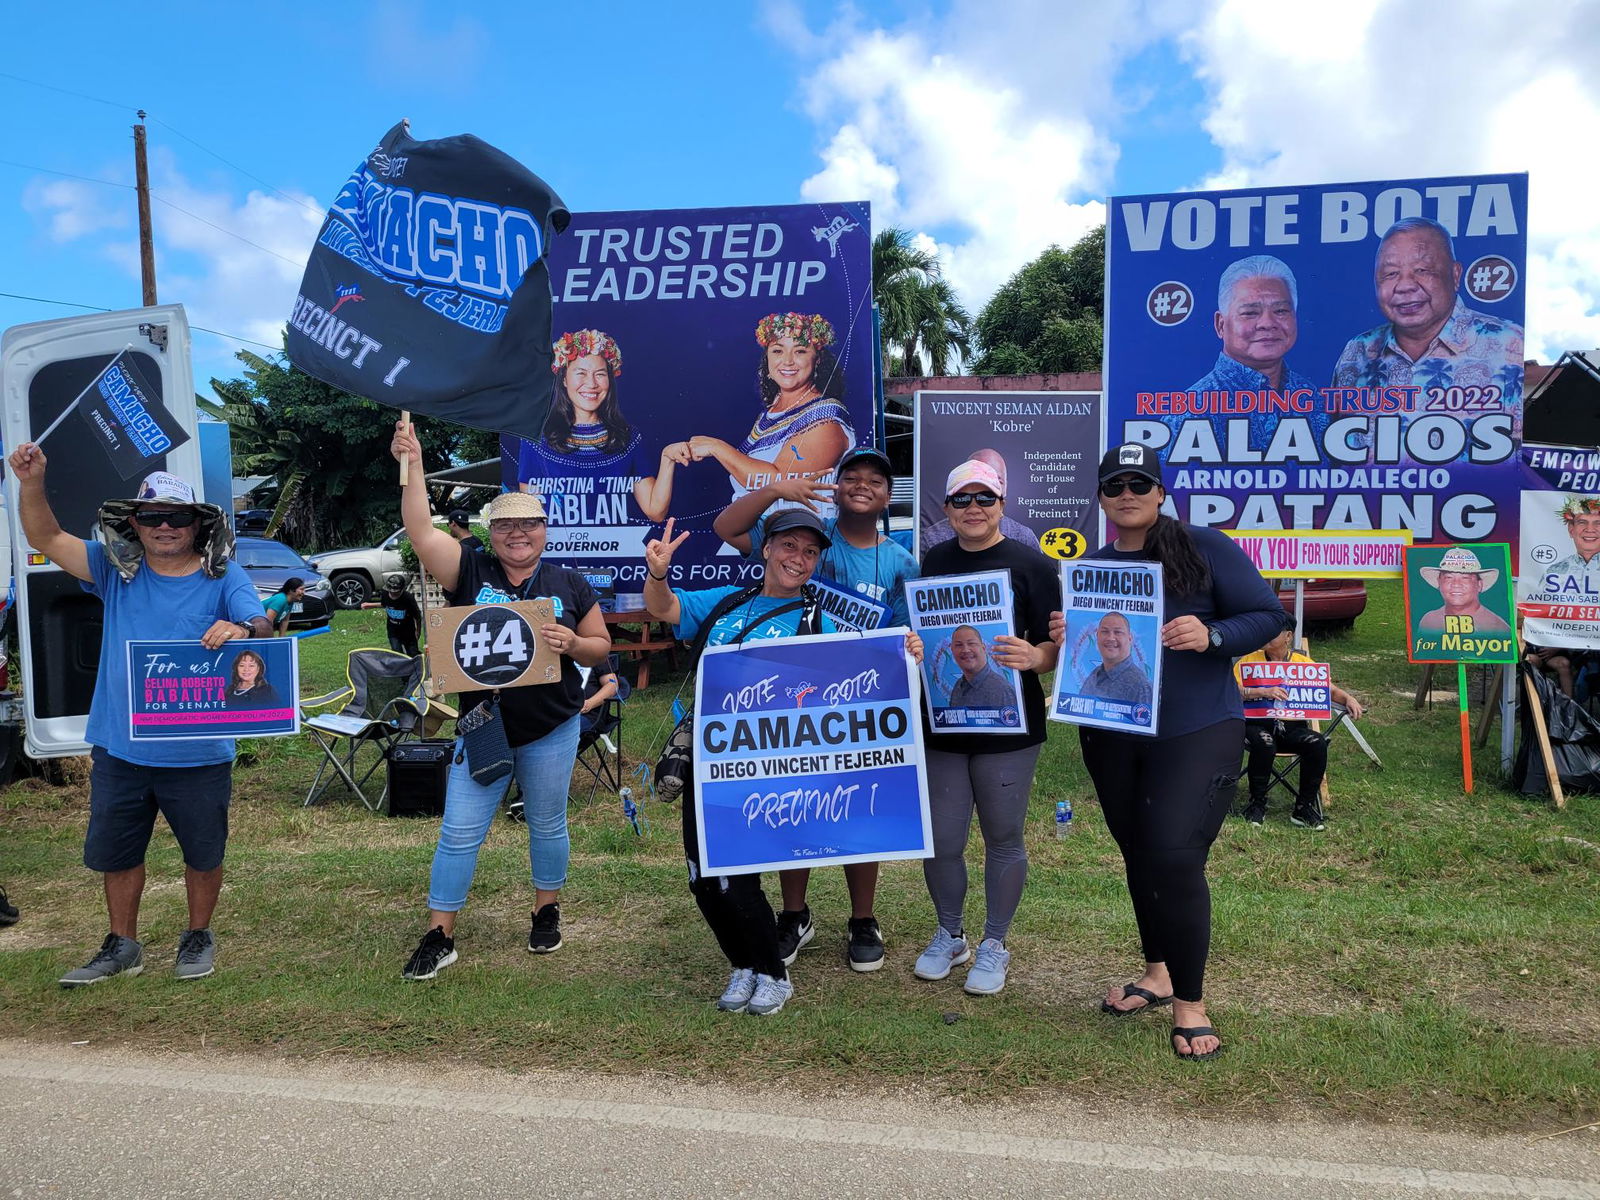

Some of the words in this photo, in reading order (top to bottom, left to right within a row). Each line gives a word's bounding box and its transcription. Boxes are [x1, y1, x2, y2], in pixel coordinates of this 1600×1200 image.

[1121, 194, 1300, 252] VOTE
[1321, 183, 1518, 244] BOTA
[574, 223, 784, 264] TRUSTED
[553, 260, 826, 303] EADERSHIP
[1473, 265, 1511, 292] #2
[1153, 290, 1189, 316] #2
[291, 294, 383, 369] RECINCT
[104, 365, 171, 454] CAMACHO
[931, 402, 992, 415] VINCENT
[995, 402, 1042, 415] SEMAN
[1045, 402, 1092, 415] ALDAN
[1136, 389, 1313, 415] REBUILDING
[1321, 385, 1422, 413] TRUST
[1426, 385, 1502, 411] 2022
[91, 409, 118, 444] PRECINCT
[989, 420, 1035, 432] 'Kobre'
[1124, 413, 1515, 465] PALACIOS
[1024, 451, 1082, 461] Independent
[1029, 462, 1076, 471] Candidate
[528, 477, 594, 495] CHRISTINA
[1030, 474, 1044, 482] for
[1046, 474, 1075, 483] House
[1174, 468, 1286, 489] ARNOLD
[1298, 467, 1451, 489] INDALECIO
[1557, 472, 1600, 491] PEO
[1048, 485, 1058, 494] of
[1018, 497, 1089, 506] Representatives
[1028, 509, 1071, 518] Precinct
[569, 532, 589, 540] FOR
[1045, 531, 1078, 558] #3
[544, 541, 619, 551] GOVERNOR
[1267, 538, 1298, 570] YOU
[1302, 543, 1321, 564] FOR
[1323, 544, 1350, 565] YOUR
[1536, 549, 1553, 560] #5
[690, 564, 731, 580] FOR
[737, 564, 765, 580] YO
[1072, 569, 1154, 597] CAMACHO
[915, 582, 1000, 613] CAMACHO
[1072, 596, 1093, 608] DIEGO
[1094, 598, 1125, 611] VINCENT
[1126, 600, 1154, 613] FEJERAN
[1526, 594, 1576, 602] ANDREW
[920, 614, 941, 627] DIEGO
[942, 612, 971, 626] VINCENT
[972, 610, 1002, 623] FEJERAN
[1548, 606, 1574, 618] FOR
[1444, 615, 1474, 634] RB
[459, 619, 528, 668] #4
[1415, 638, 1437, 653] for
[1441, 635, 1511, 656] Mayor
[144, 653, 181, 678] For
[189, 652, 223, 675] us!
[1242, 664, 1328, 680] PALACIOS
[145, 678, 178, 689] CELINA
[181, 676, 225, 688] ROBERTO
[722, 675, 779, 714] VOTE
[822, 668, 880, 709] BOTA
[144, 689, 226, 703] BABAUTA
[178, 701, 227, 710] SENATE
[1266, 709, 1306, 717] 2022
[703, 706, 908, 753] CAMACHO
[710, 761, 757, 780] DIEGO
[761, 755, 830, 776] VINCENT
[834, 748, 905, 770] FEJERAN
[742, 784, 860, 829] PRECINCT
